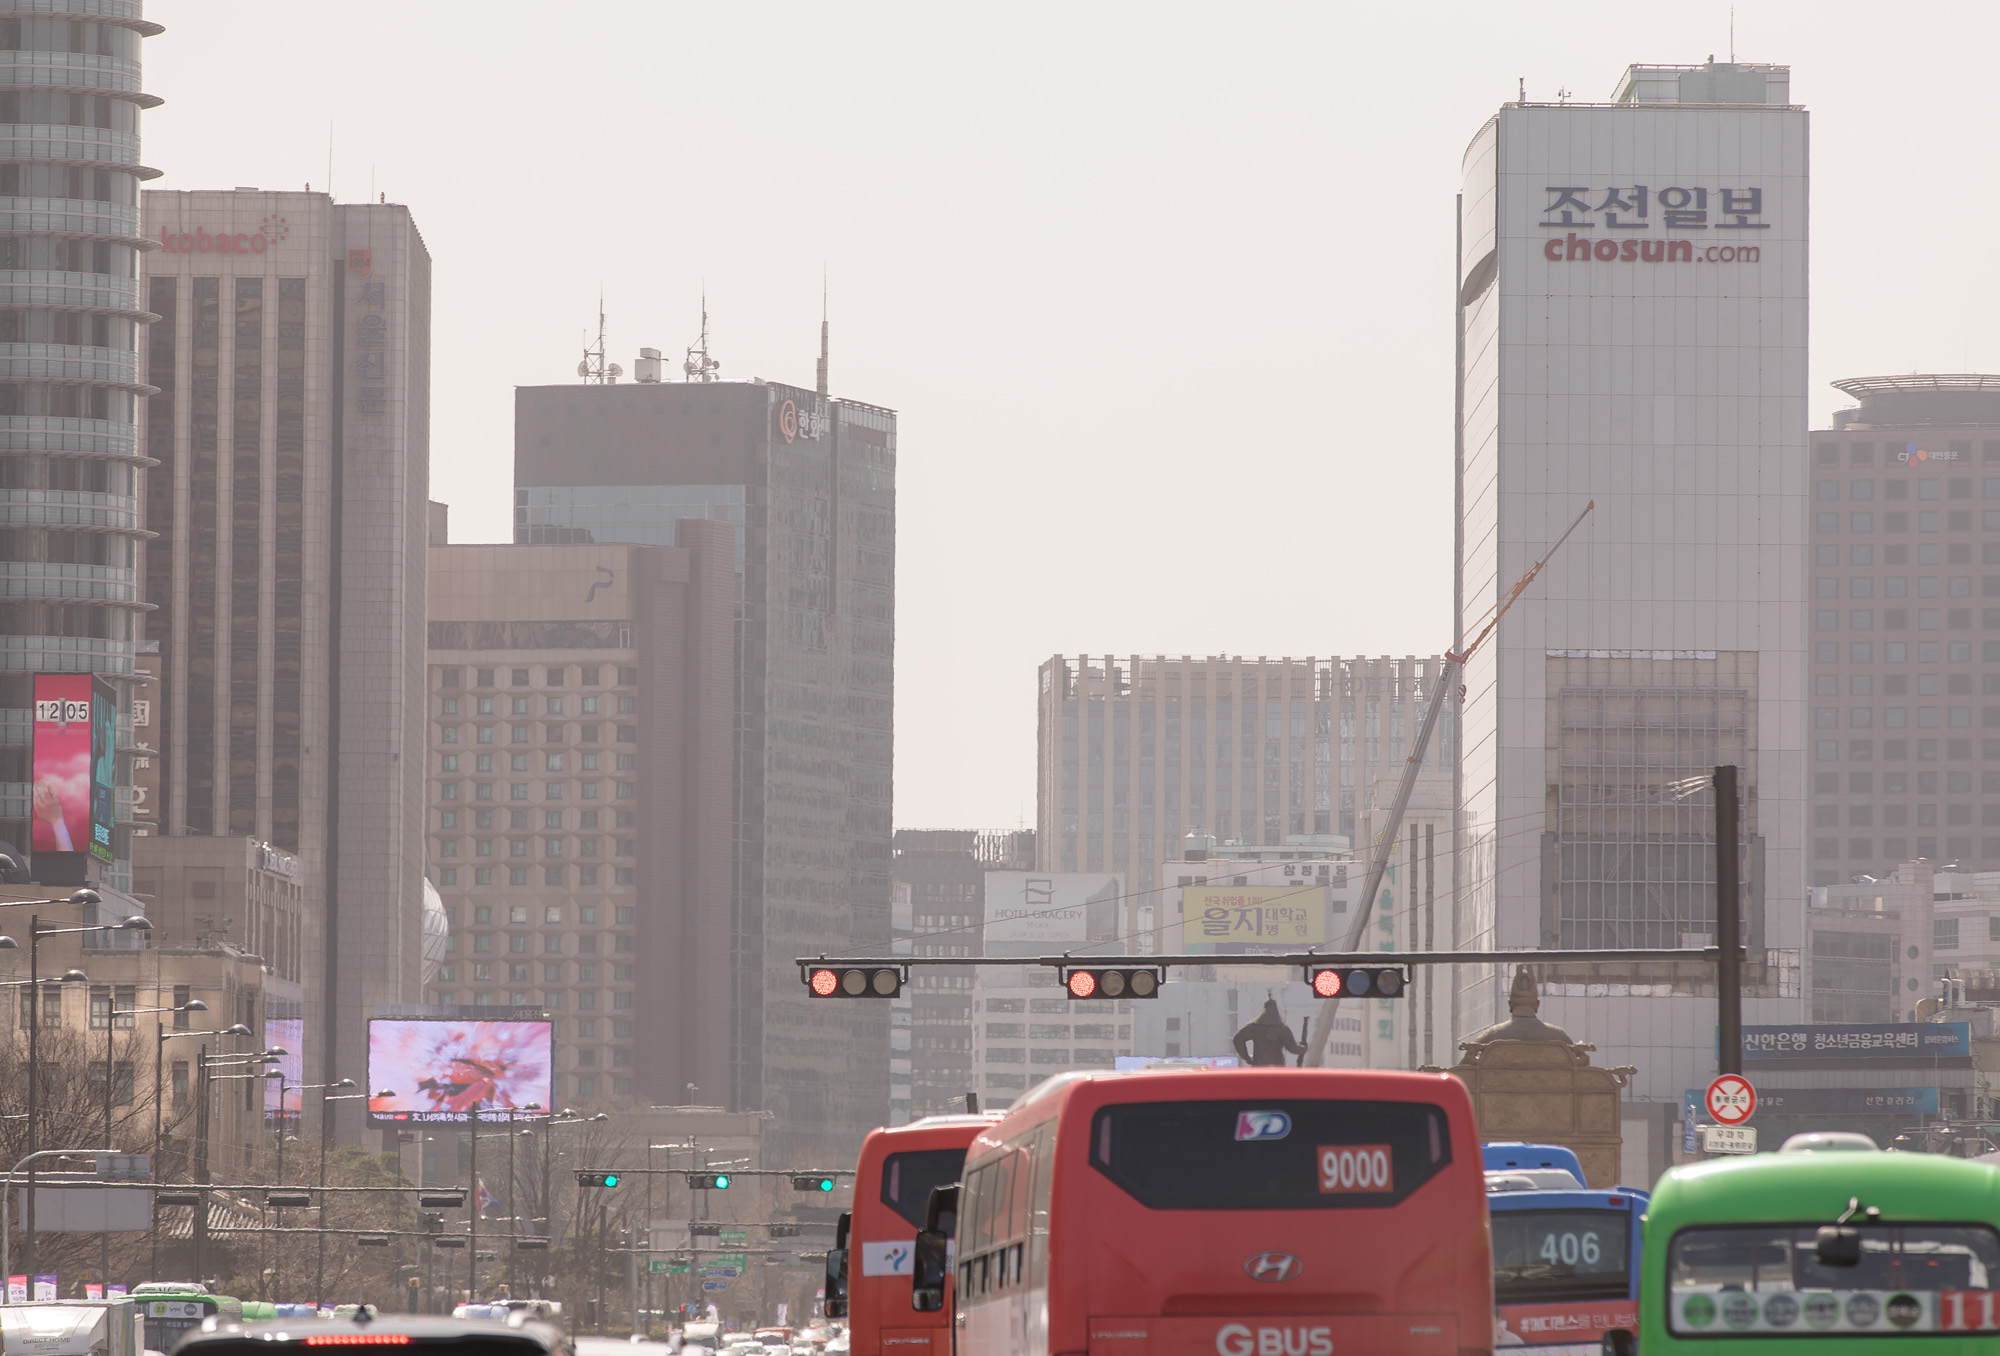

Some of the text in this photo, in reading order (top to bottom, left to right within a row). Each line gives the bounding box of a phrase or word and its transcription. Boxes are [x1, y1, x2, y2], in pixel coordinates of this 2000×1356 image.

[1539, 184, 1771, 229] 조선일보
[161, 225, 267, 254] kobaco
[1544, 232, 1761, 263] chosun.com
[355, 282, 388, 415] 서울신문
[798, 409, 820, 441] 한화
[995, 908, 1083, 920] HOTEL GRACERY
[1202, 907, 1262, 936] 을지
[1745, 1032, 1807, 1051] 신한은행
[1814, 1032, 1918, 1050] 청소년금융교육센터
[1322, 1149, 1388, 1189] 9000
[1540, 1232, 1600, 1265] 406
[22, 1336, 71, 1345] DIRECT HOME
